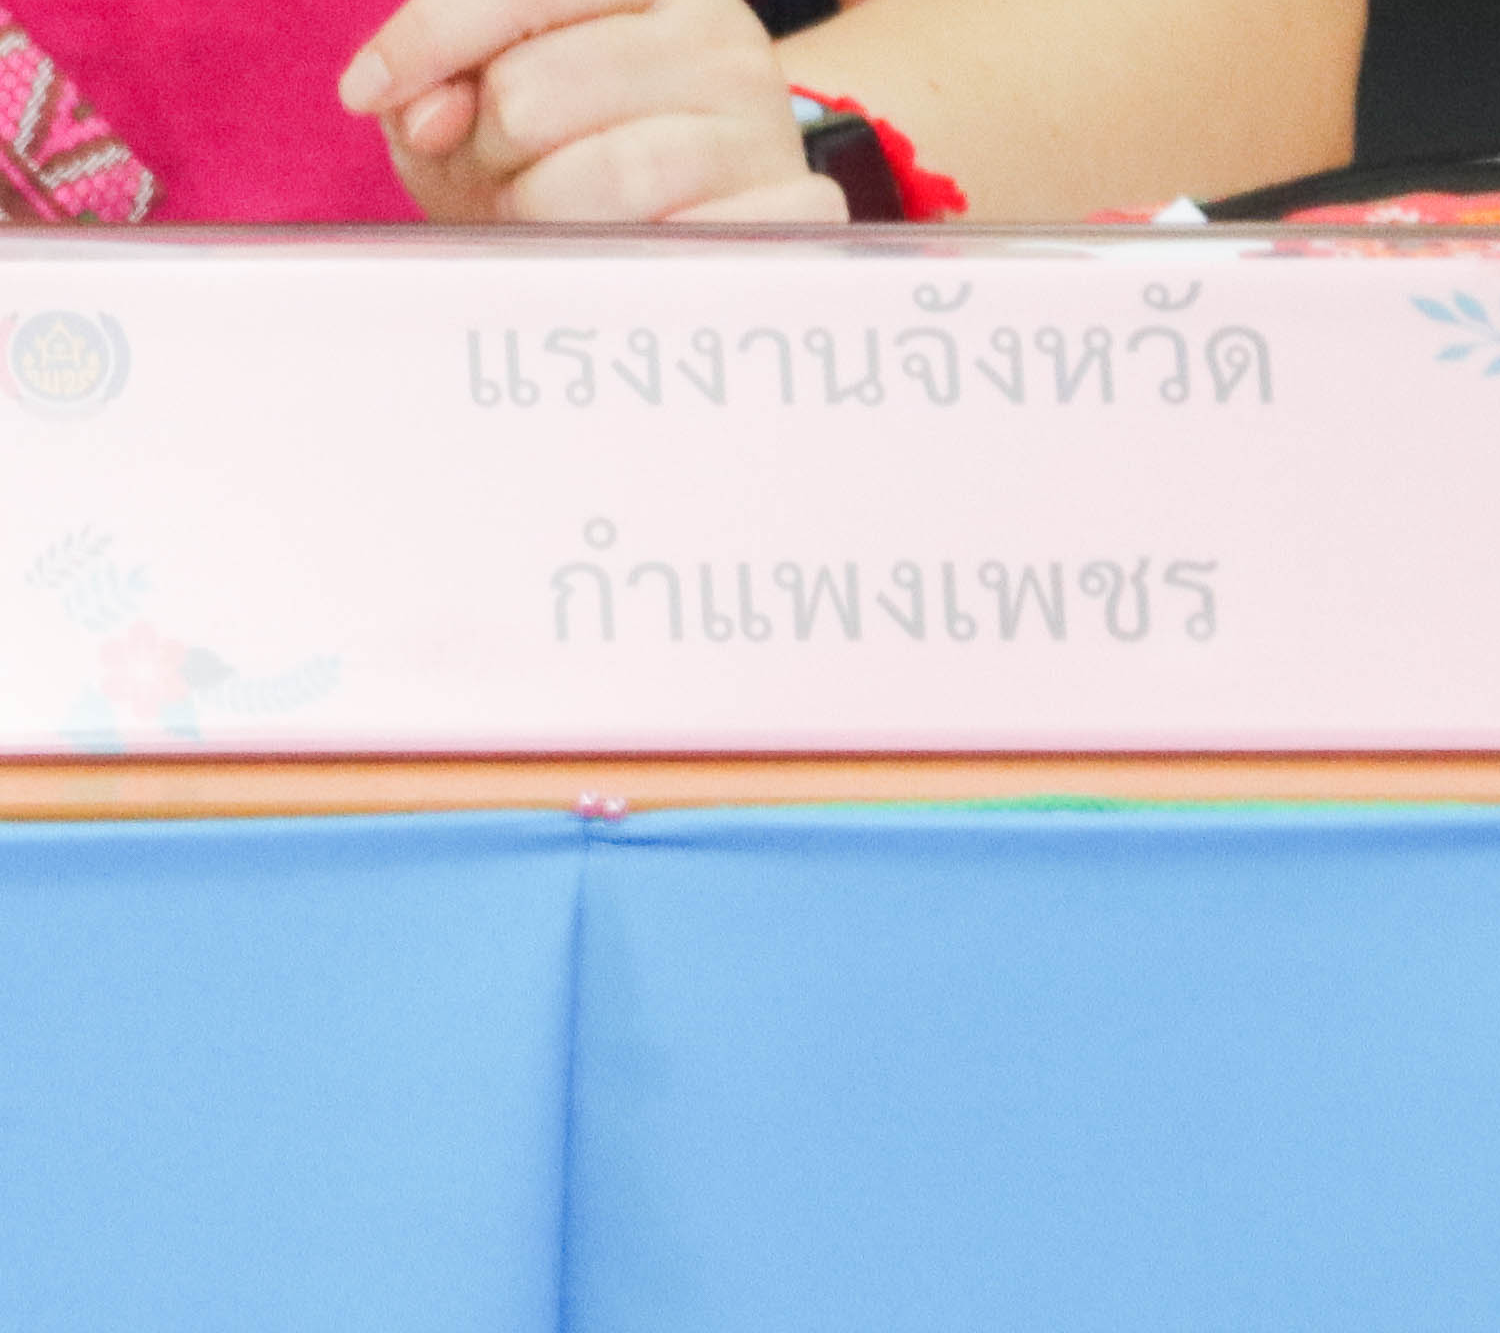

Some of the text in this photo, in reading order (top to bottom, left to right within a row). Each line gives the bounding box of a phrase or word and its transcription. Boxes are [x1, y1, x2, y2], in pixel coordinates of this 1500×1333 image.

[465, 281, 1276, 408] แรงงานจังหวัด
[549, 516, 1219, 642] กำแพงเพชร
